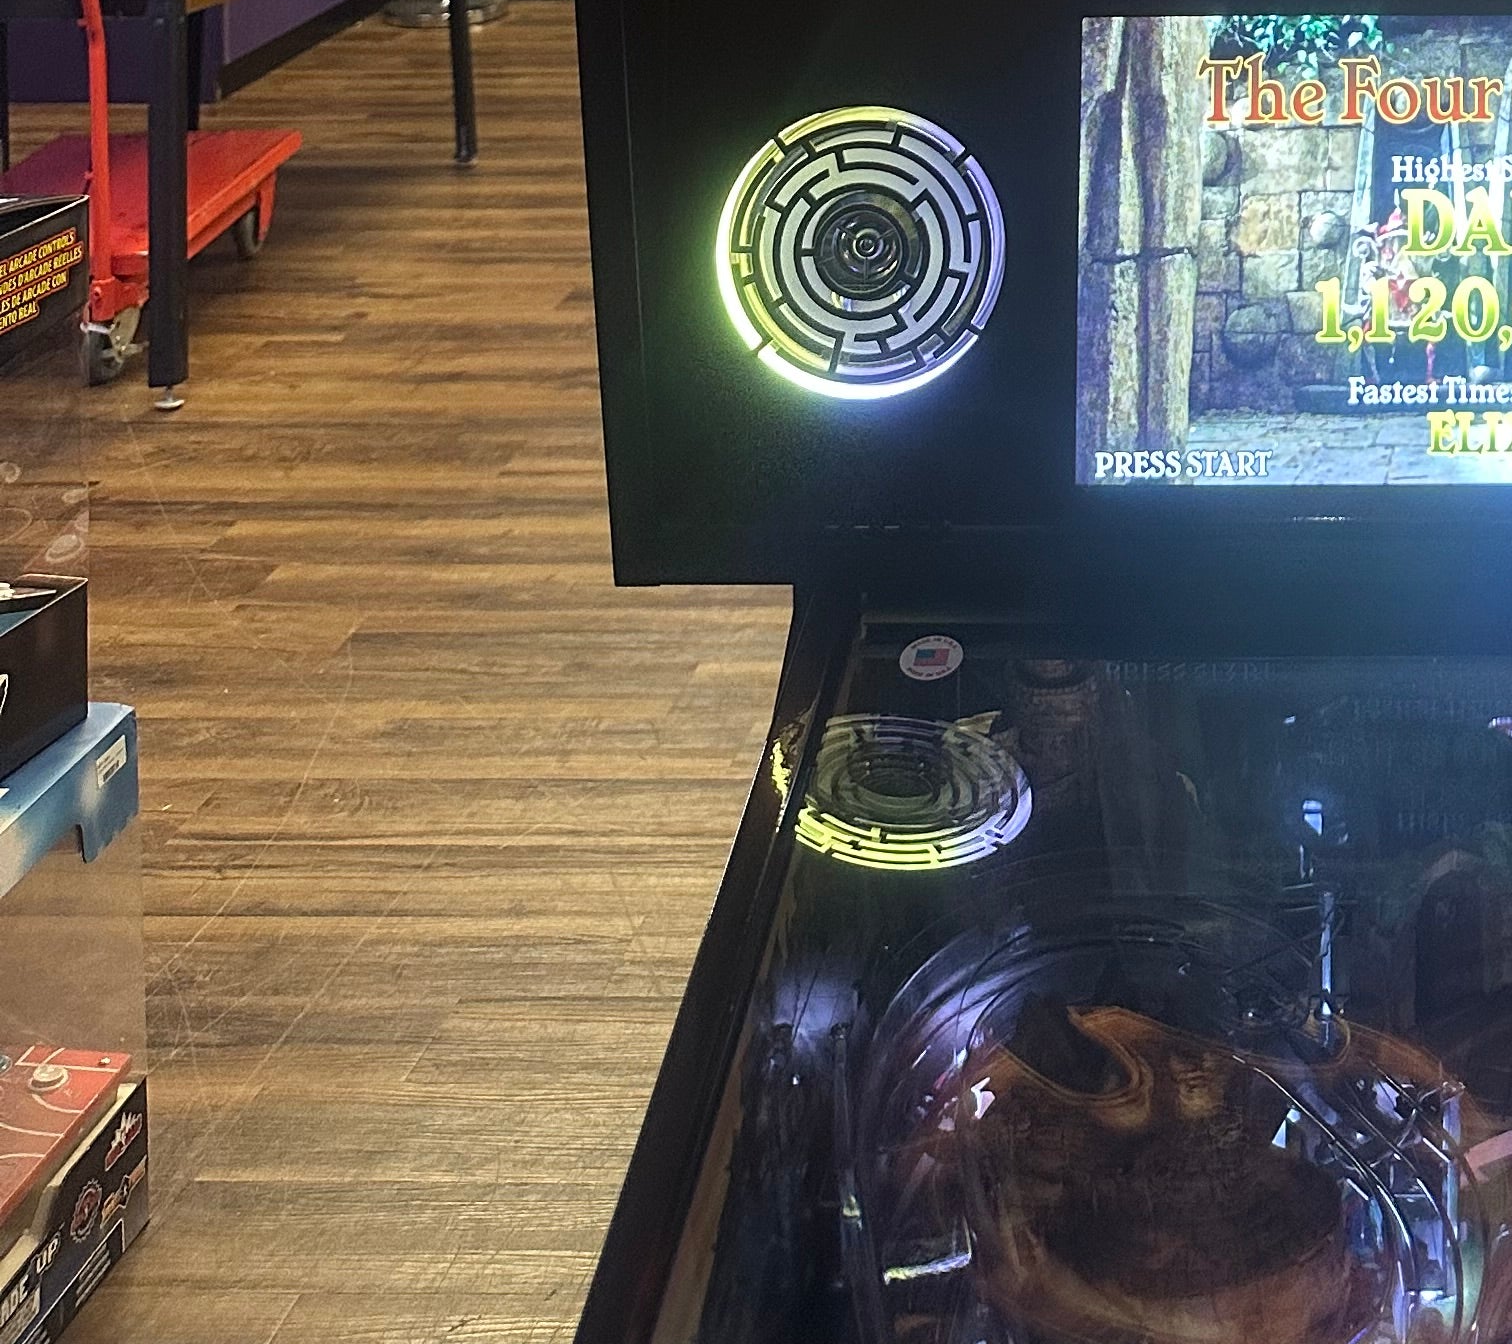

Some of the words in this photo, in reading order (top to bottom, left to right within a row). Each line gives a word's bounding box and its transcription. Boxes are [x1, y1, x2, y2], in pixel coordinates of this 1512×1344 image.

[1199, 53, 1327, 125] The
[1339, 54, 1504, 125] Four
[1391, 155, 1494, 189] Highest
[9, 248, 38, 274] ARCADE
[38, 231, 75, 259] CONTROLS
[17, 259, 53, 288] D'ARCADE
[11, 295, 21, 309] DE
[22, 277, 51, 304] ARCADE
[51, 272, 68, 289] CON
[18, 300, 38, 321] REAL
[1347, 375, 1440, 405] Fastest
[1094, 449, 1181, 480] PRESS
[1185, 449, 1274, 478] START
